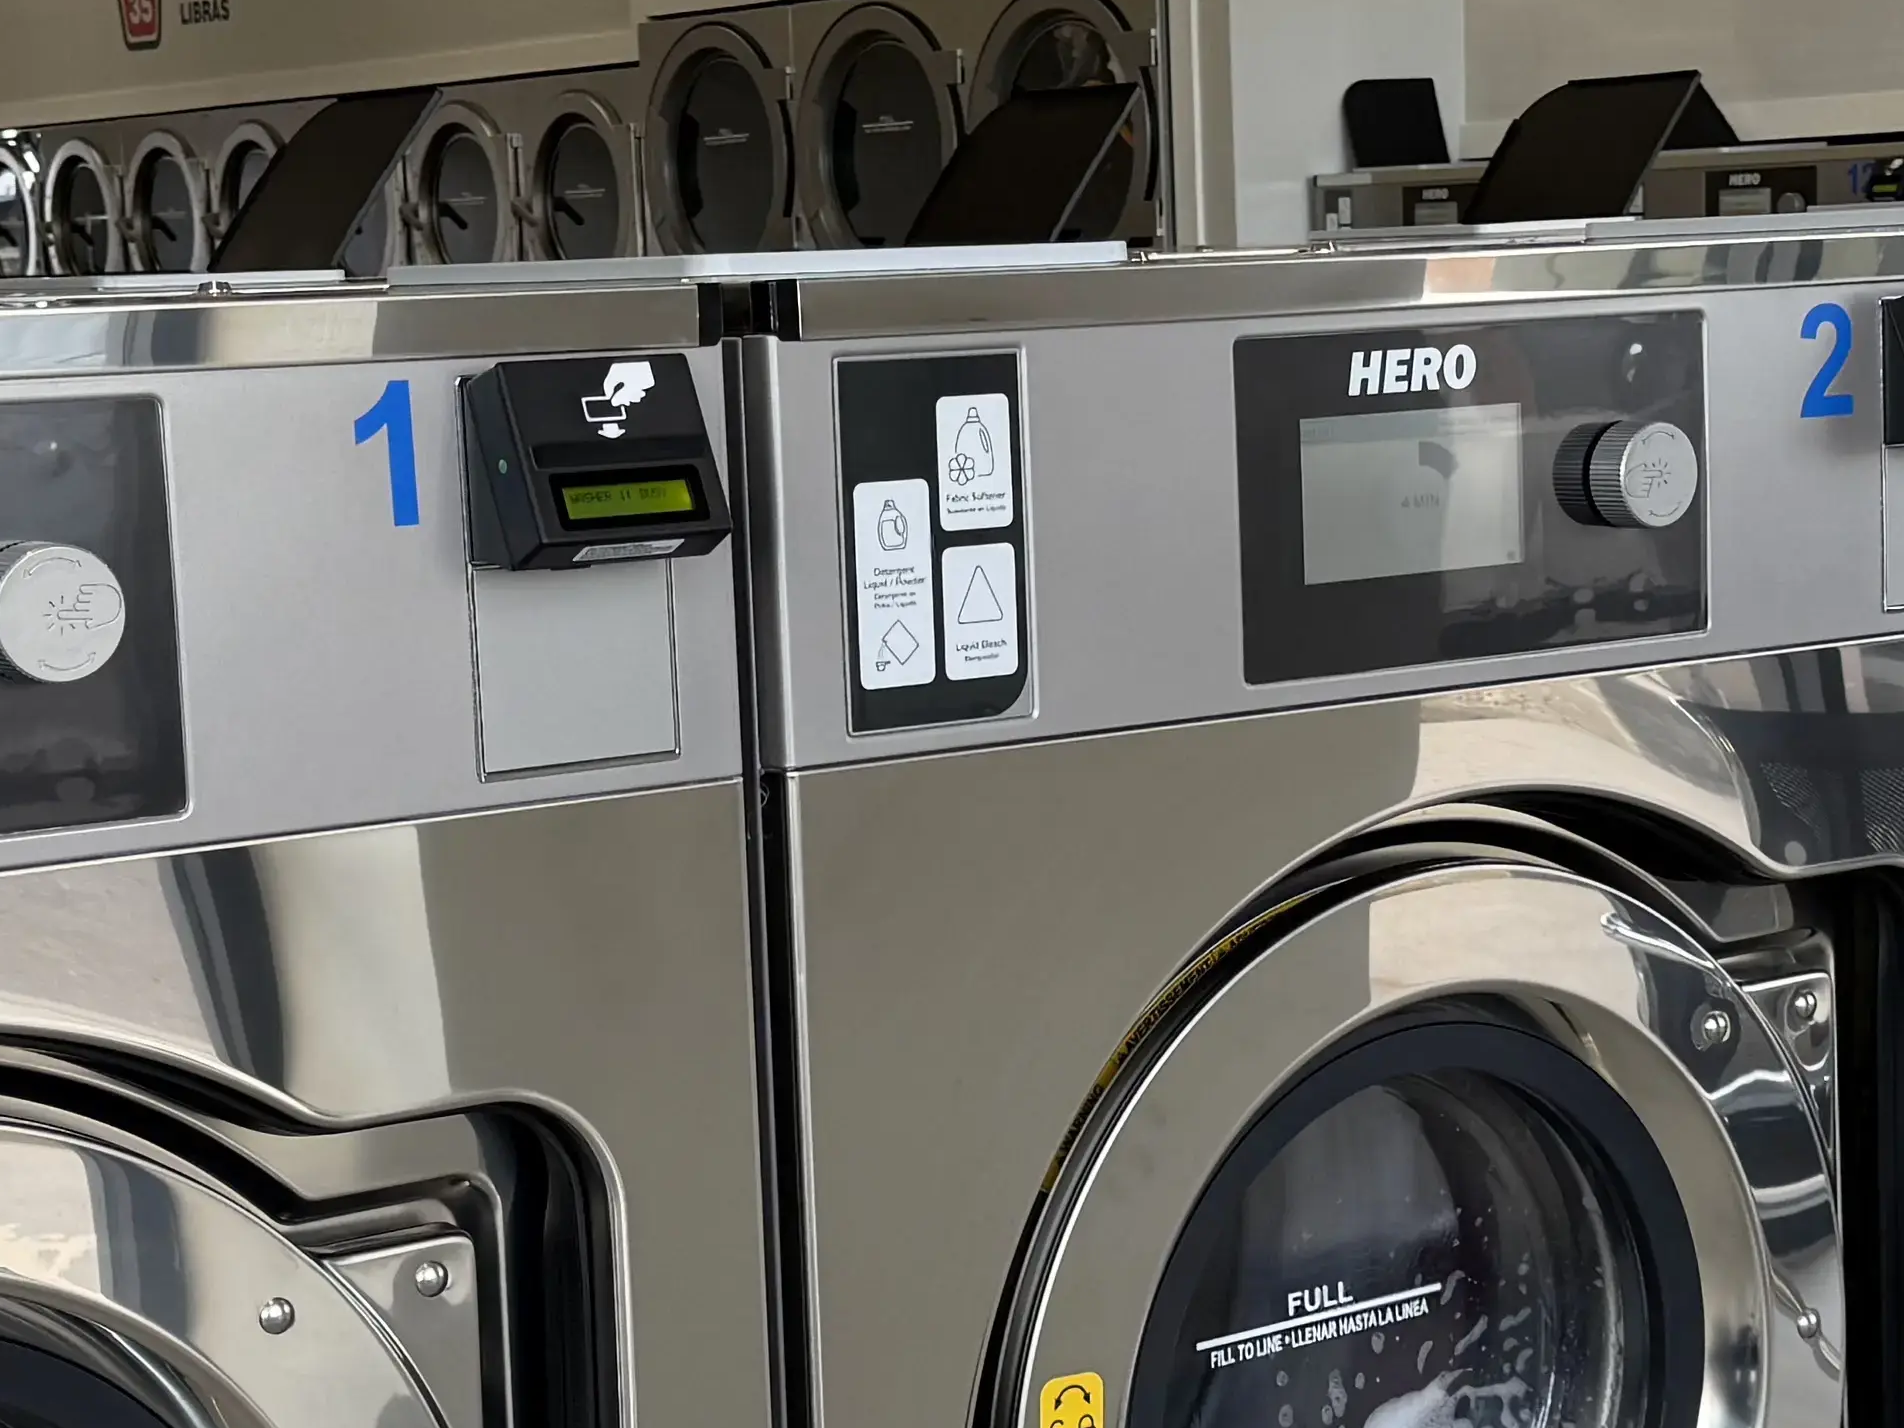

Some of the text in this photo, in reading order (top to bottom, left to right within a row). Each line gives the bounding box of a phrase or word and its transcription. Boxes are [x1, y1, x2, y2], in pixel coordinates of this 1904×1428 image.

[1348, 343, 1477, 397] HERO
[1800, 302, 1854, 418] 2
[354, 380, 420, 527] 1
[1210, 1297, 1429, 1369] FILL TO LINE LLENAR HASTA LA LINEA
[1287, 1281, 1354, 1317] FULL
